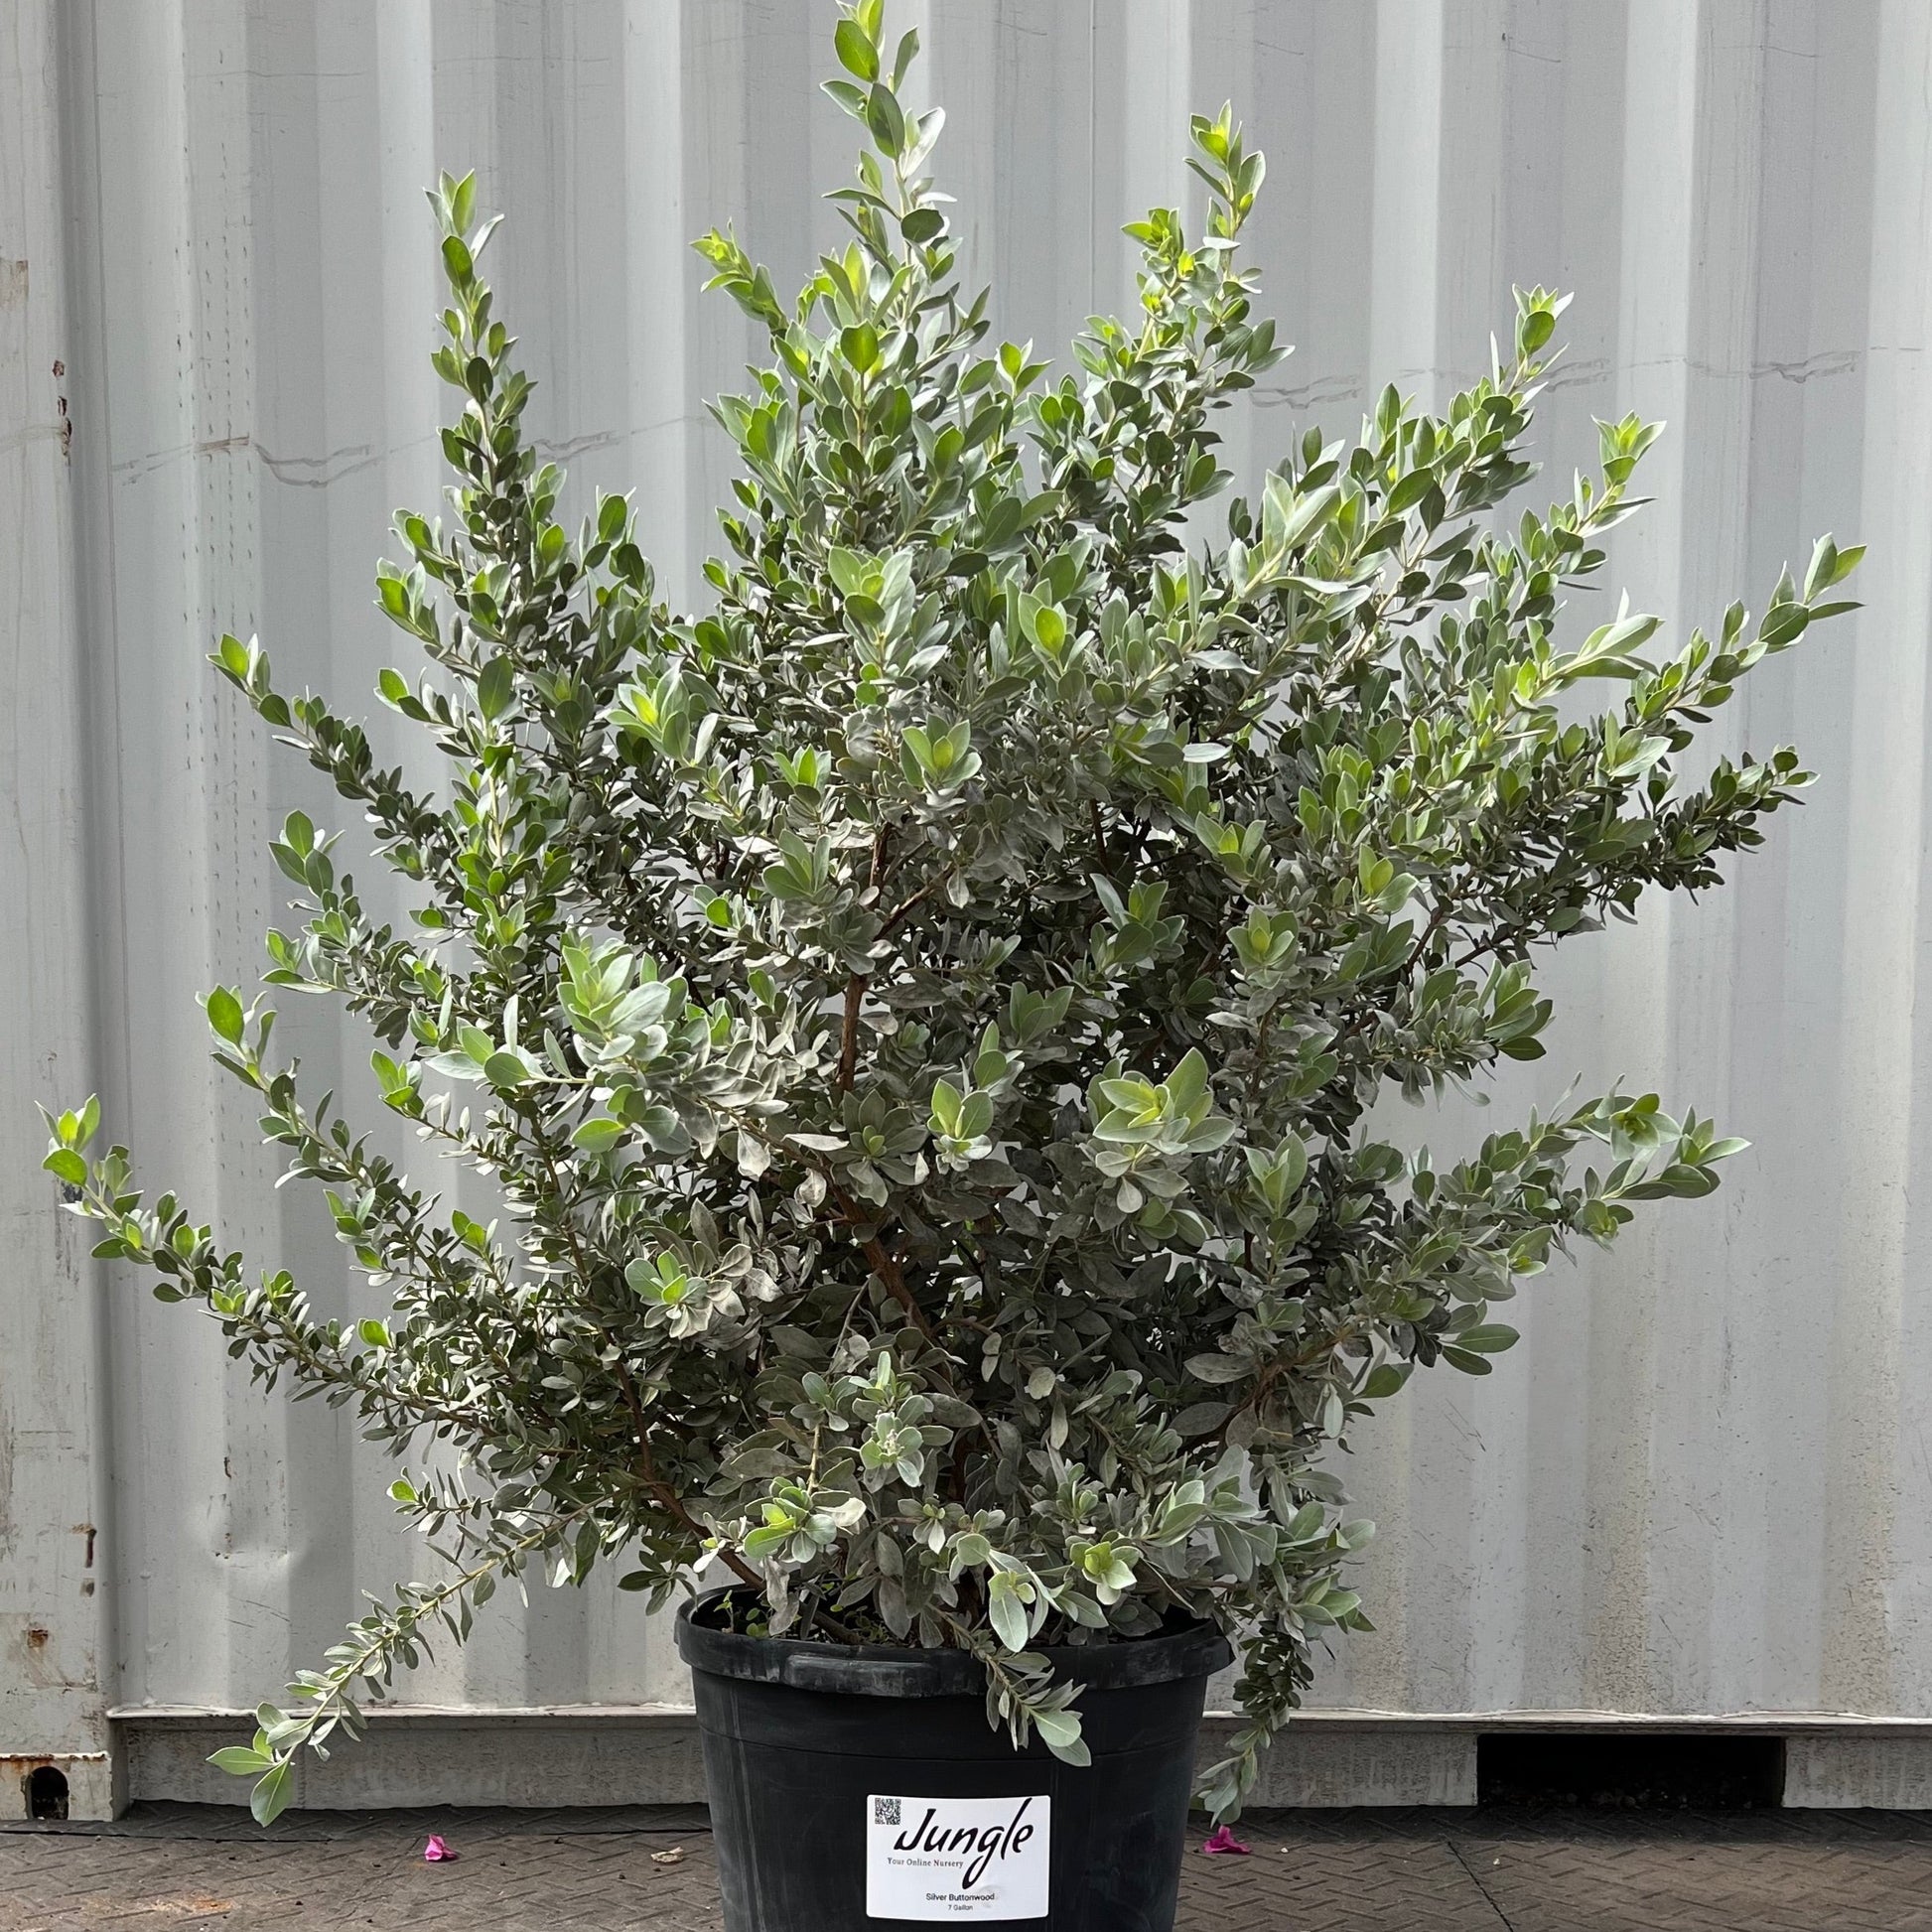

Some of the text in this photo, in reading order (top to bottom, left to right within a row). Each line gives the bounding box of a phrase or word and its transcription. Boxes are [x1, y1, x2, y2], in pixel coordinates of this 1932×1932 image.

[894, 1797, 1035, 1890] Jungle
[887, 1857, 964, 1869] Your Online Nursery
[925, 1892, 995, 1902] Silver Buttonwood
